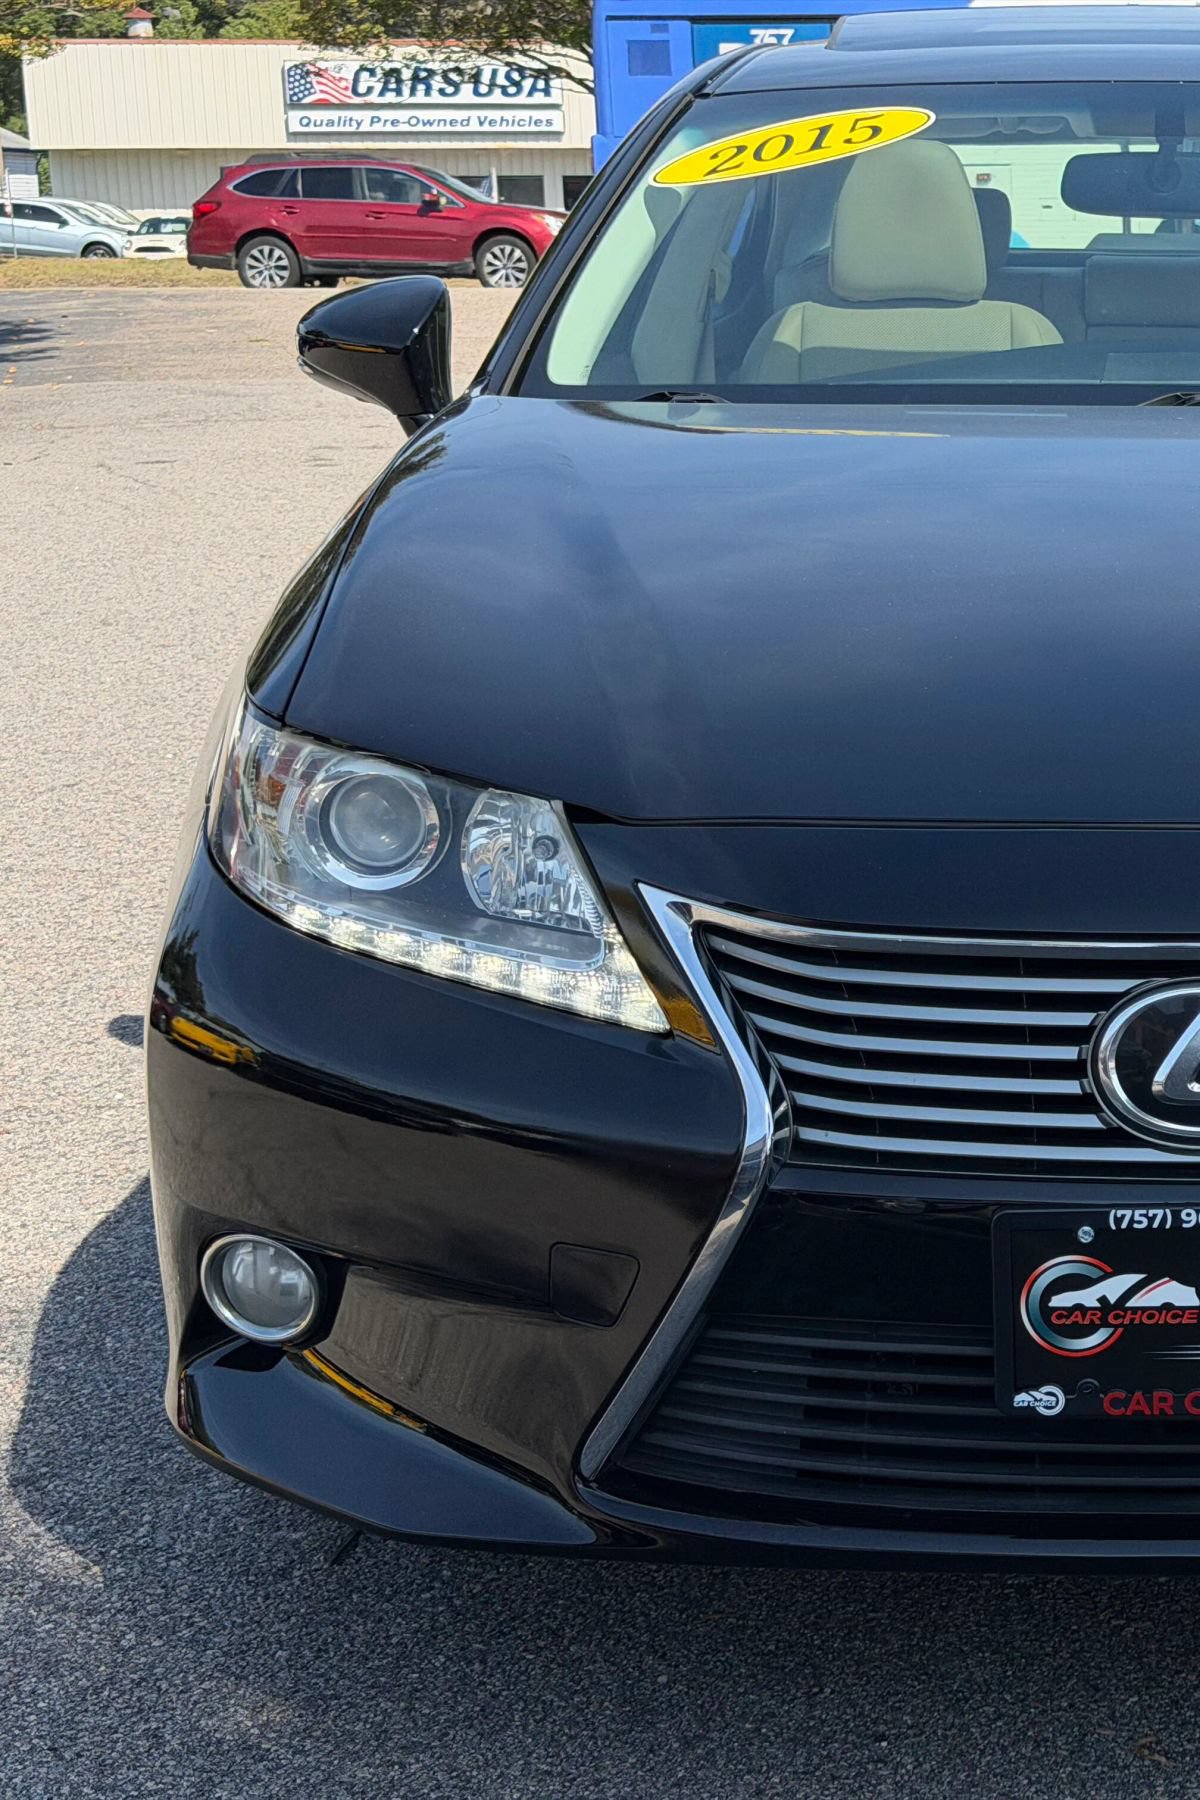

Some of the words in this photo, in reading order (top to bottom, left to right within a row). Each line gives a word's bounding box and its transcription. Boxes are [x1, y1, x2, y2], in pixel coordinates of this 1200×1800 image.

[351, 66, 460, 98] CARS
[471, 66, 553, 98] USA
[298, 115, 364, 130] Quality
[369, 115, 470, 129] Pre-Owned
[478, 115, 554, 129] Vehicles
[702, 113, 885, 178] 2015
[1109, 1208, 1172, 1230] (757)
[1051, 1309, 1101, 1325] CAR
[1107, 1308, 1199, 1325] CHOICE
[1103, 1391, 1175, 1416] CAR
